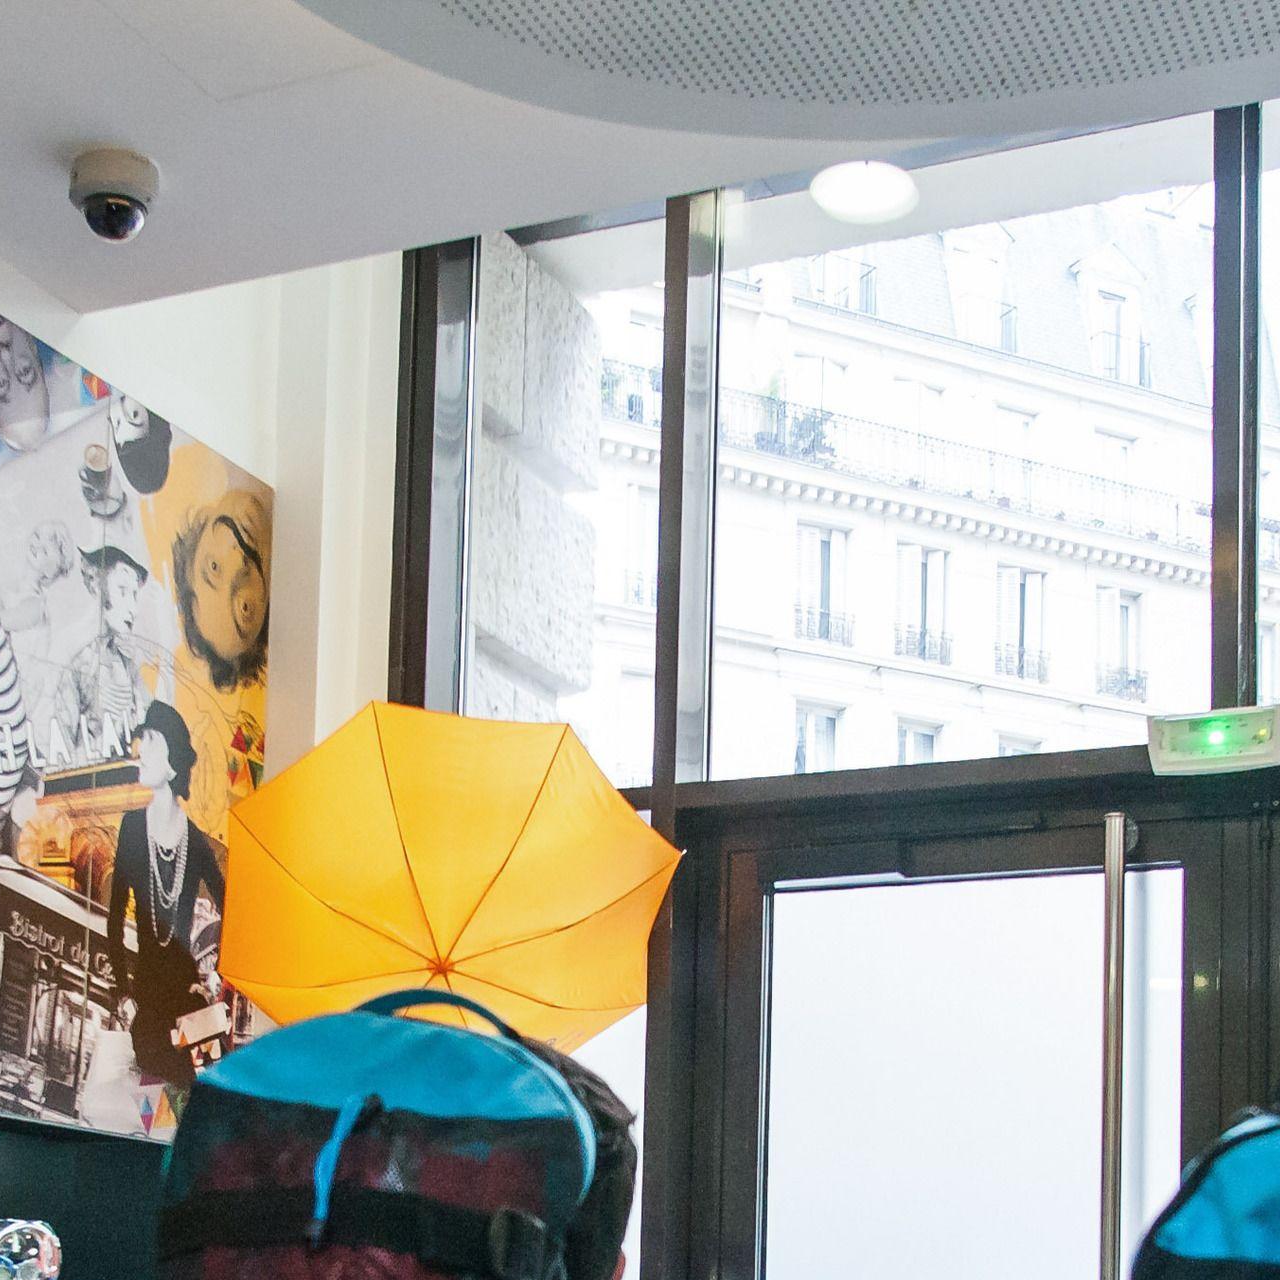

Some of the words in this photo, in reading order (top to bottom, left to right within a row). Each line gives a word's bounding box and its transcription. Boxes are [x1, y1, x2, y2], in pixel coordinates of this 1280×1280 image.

[26, 716, 72, 767] LA
[81, 710, 133, 759] LA!
[9, 910, 66, 956] Bistrot
